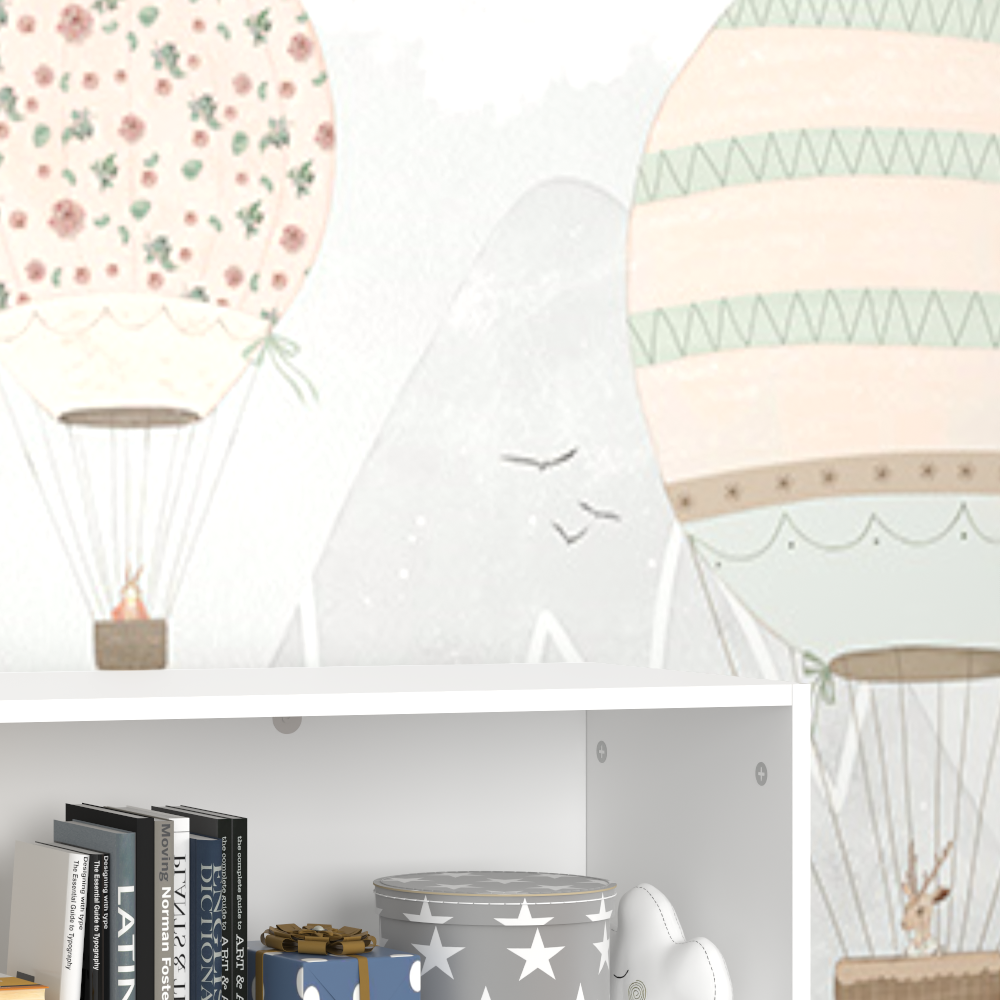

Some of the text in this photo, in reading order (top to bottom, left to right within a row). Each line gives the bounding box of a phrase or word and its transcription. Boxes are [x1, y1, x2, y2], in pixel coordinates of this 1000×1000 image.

[159, 823, 171, 882] Moving
[70, 874, 78, 904] Essential
[80, 856, 88, 895] Designing
[94, 924, 100, 932] to
[161, 886, 171, 952] Norman
[222, 921, 227, 930] to
[237, 920, 243, 931] to
[65, 933, 74, 970] Typography
[92, 933, 100, 970] Typography
[236, 934, 244, 971] ART
[222, 976, 229, 990] &
[236, 975, 244, 990] &
